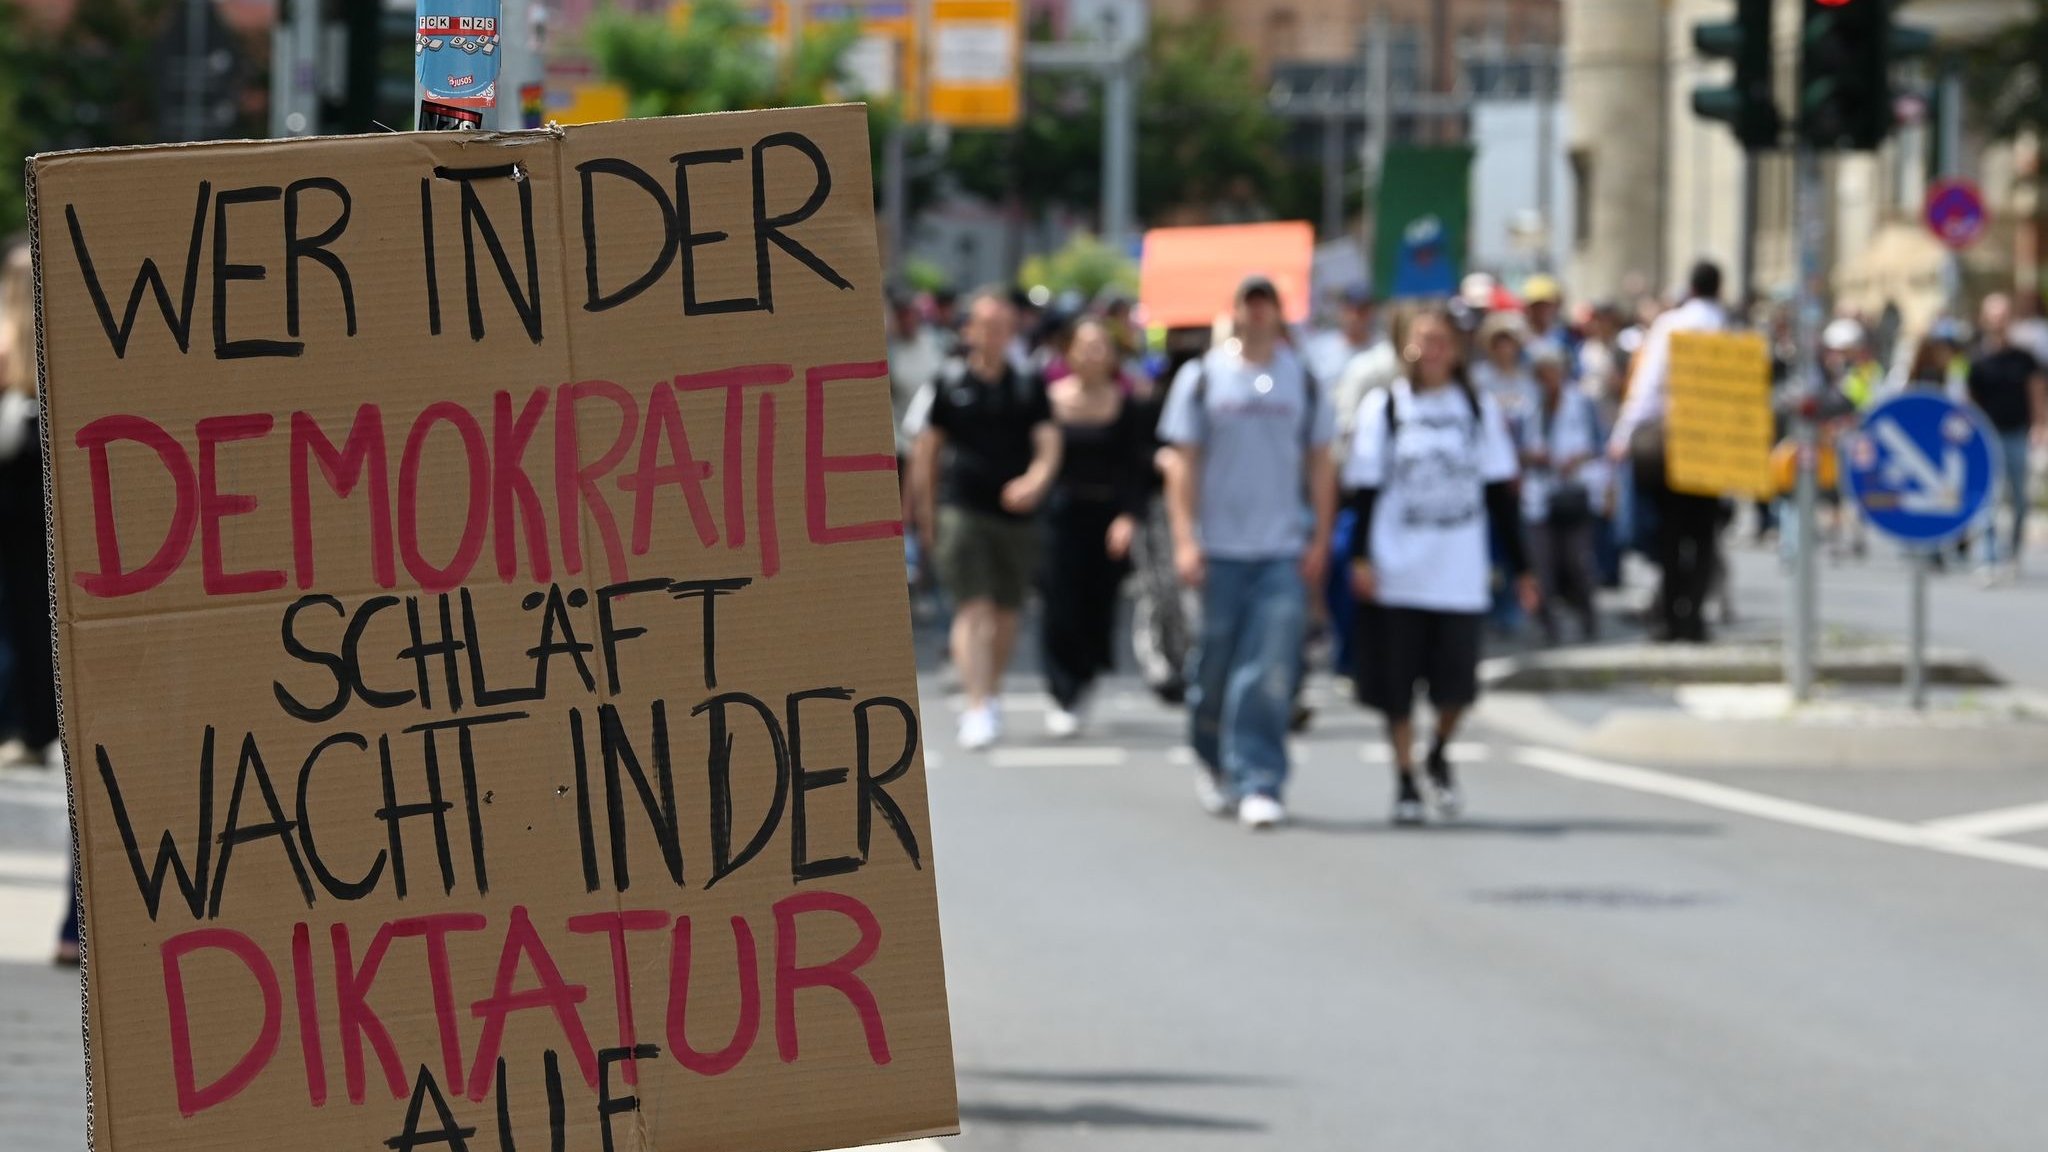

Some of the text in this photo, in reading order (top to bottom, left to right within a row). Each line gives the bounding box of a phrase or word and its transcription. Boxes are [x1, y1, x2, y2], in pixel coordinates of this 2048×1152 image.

[420, 18, 493, 29] FCK NZS
[453, 75, 473, 87] JUSOS
[66, 132, 854, 359] WER IN DER
[73, 360, 904, 600] DEMOKRATIE
[273, 577, 753, 722] SCHLÄFT
[95, 687, 922, 922] WACHT IN DER
[161, 891, 892, 1118] DIKTATUR
[383, 1043, 662, 1152] AUF
